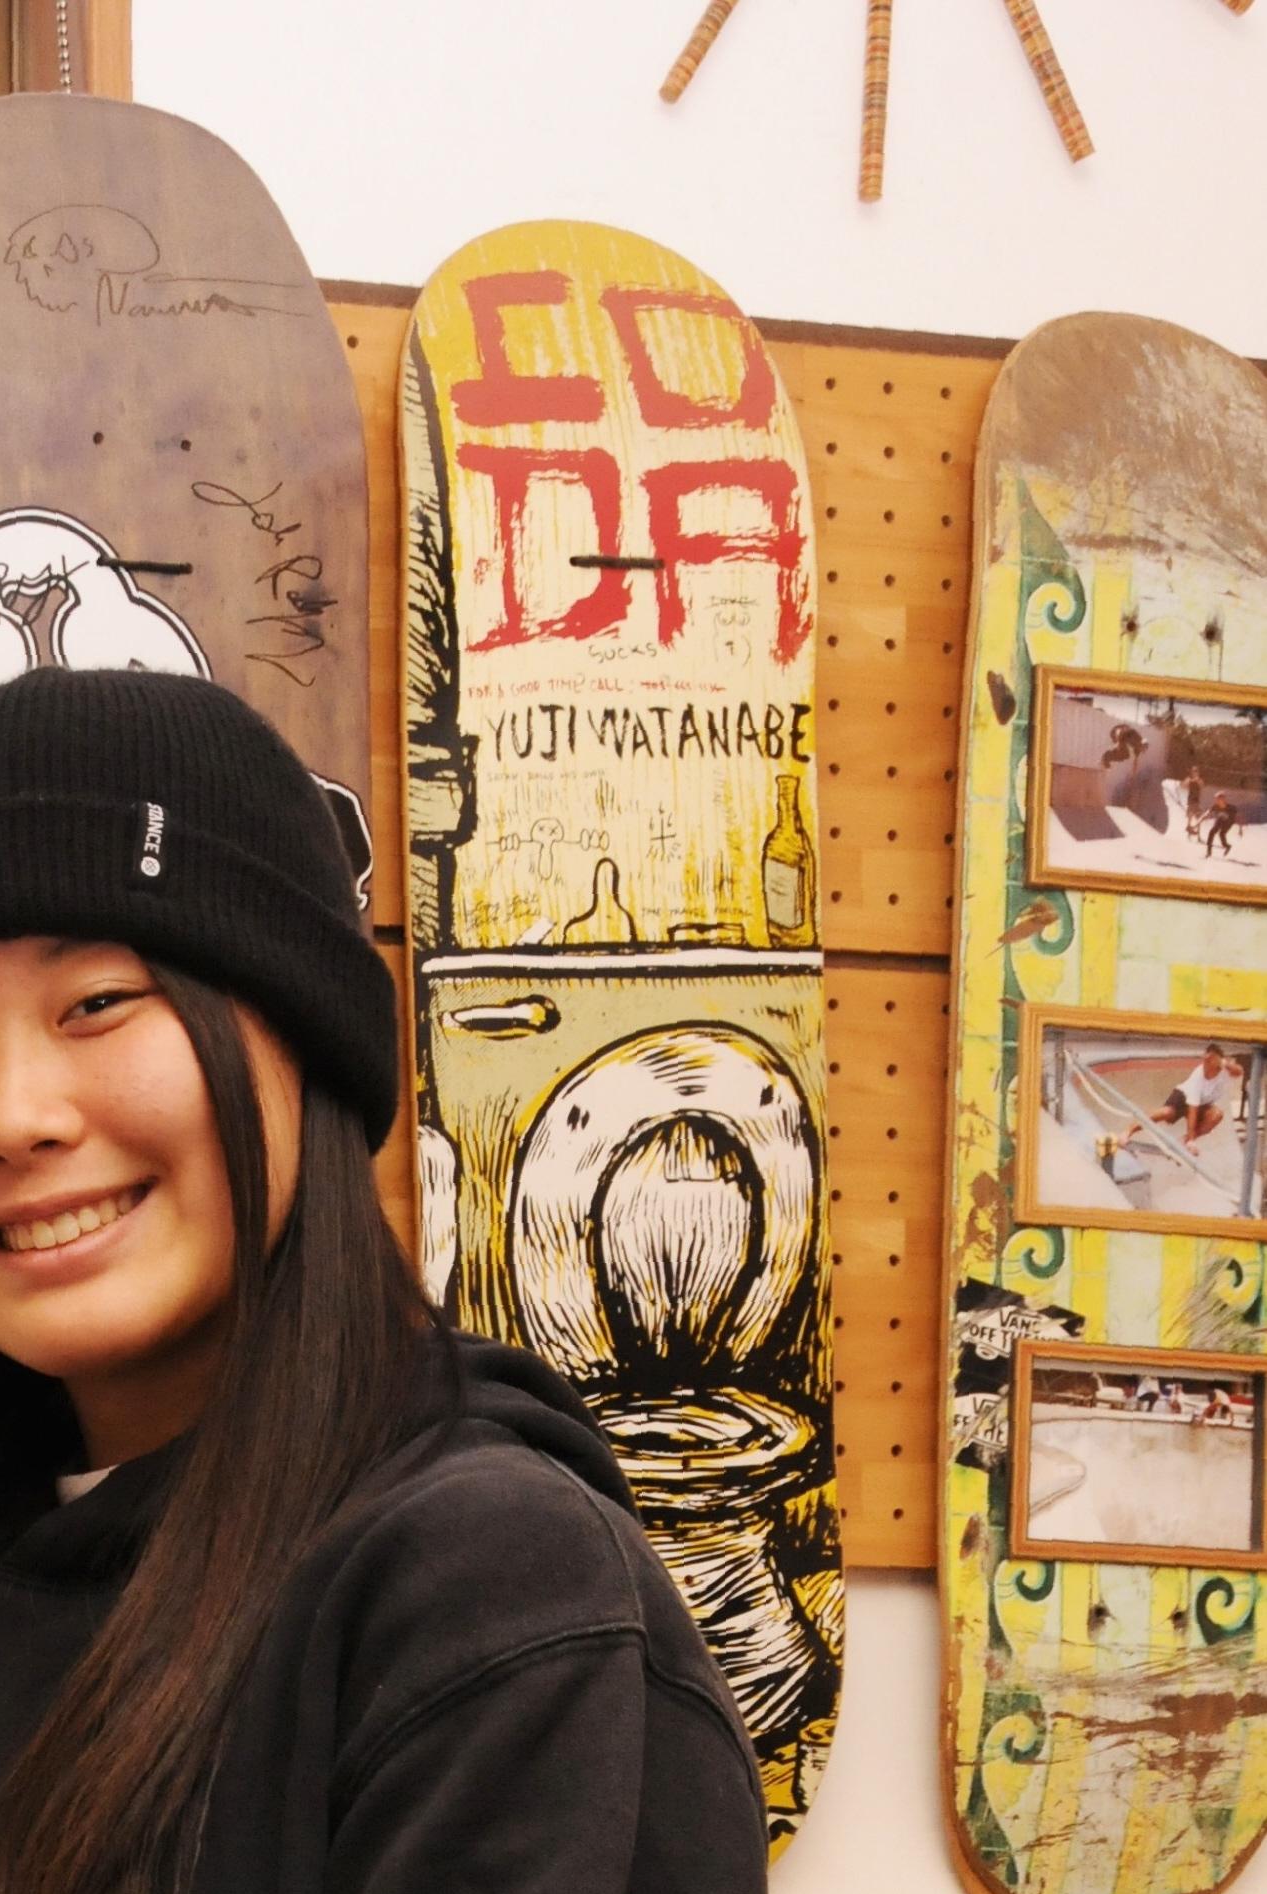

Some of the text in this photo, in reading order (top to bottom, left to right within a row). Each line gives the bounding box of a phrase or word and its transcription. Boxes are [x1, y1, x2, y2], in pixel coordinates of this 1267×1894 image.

[485, 701, 811, 763] YUJI WATANABE
[142, 802, 164, 854] STANCE
